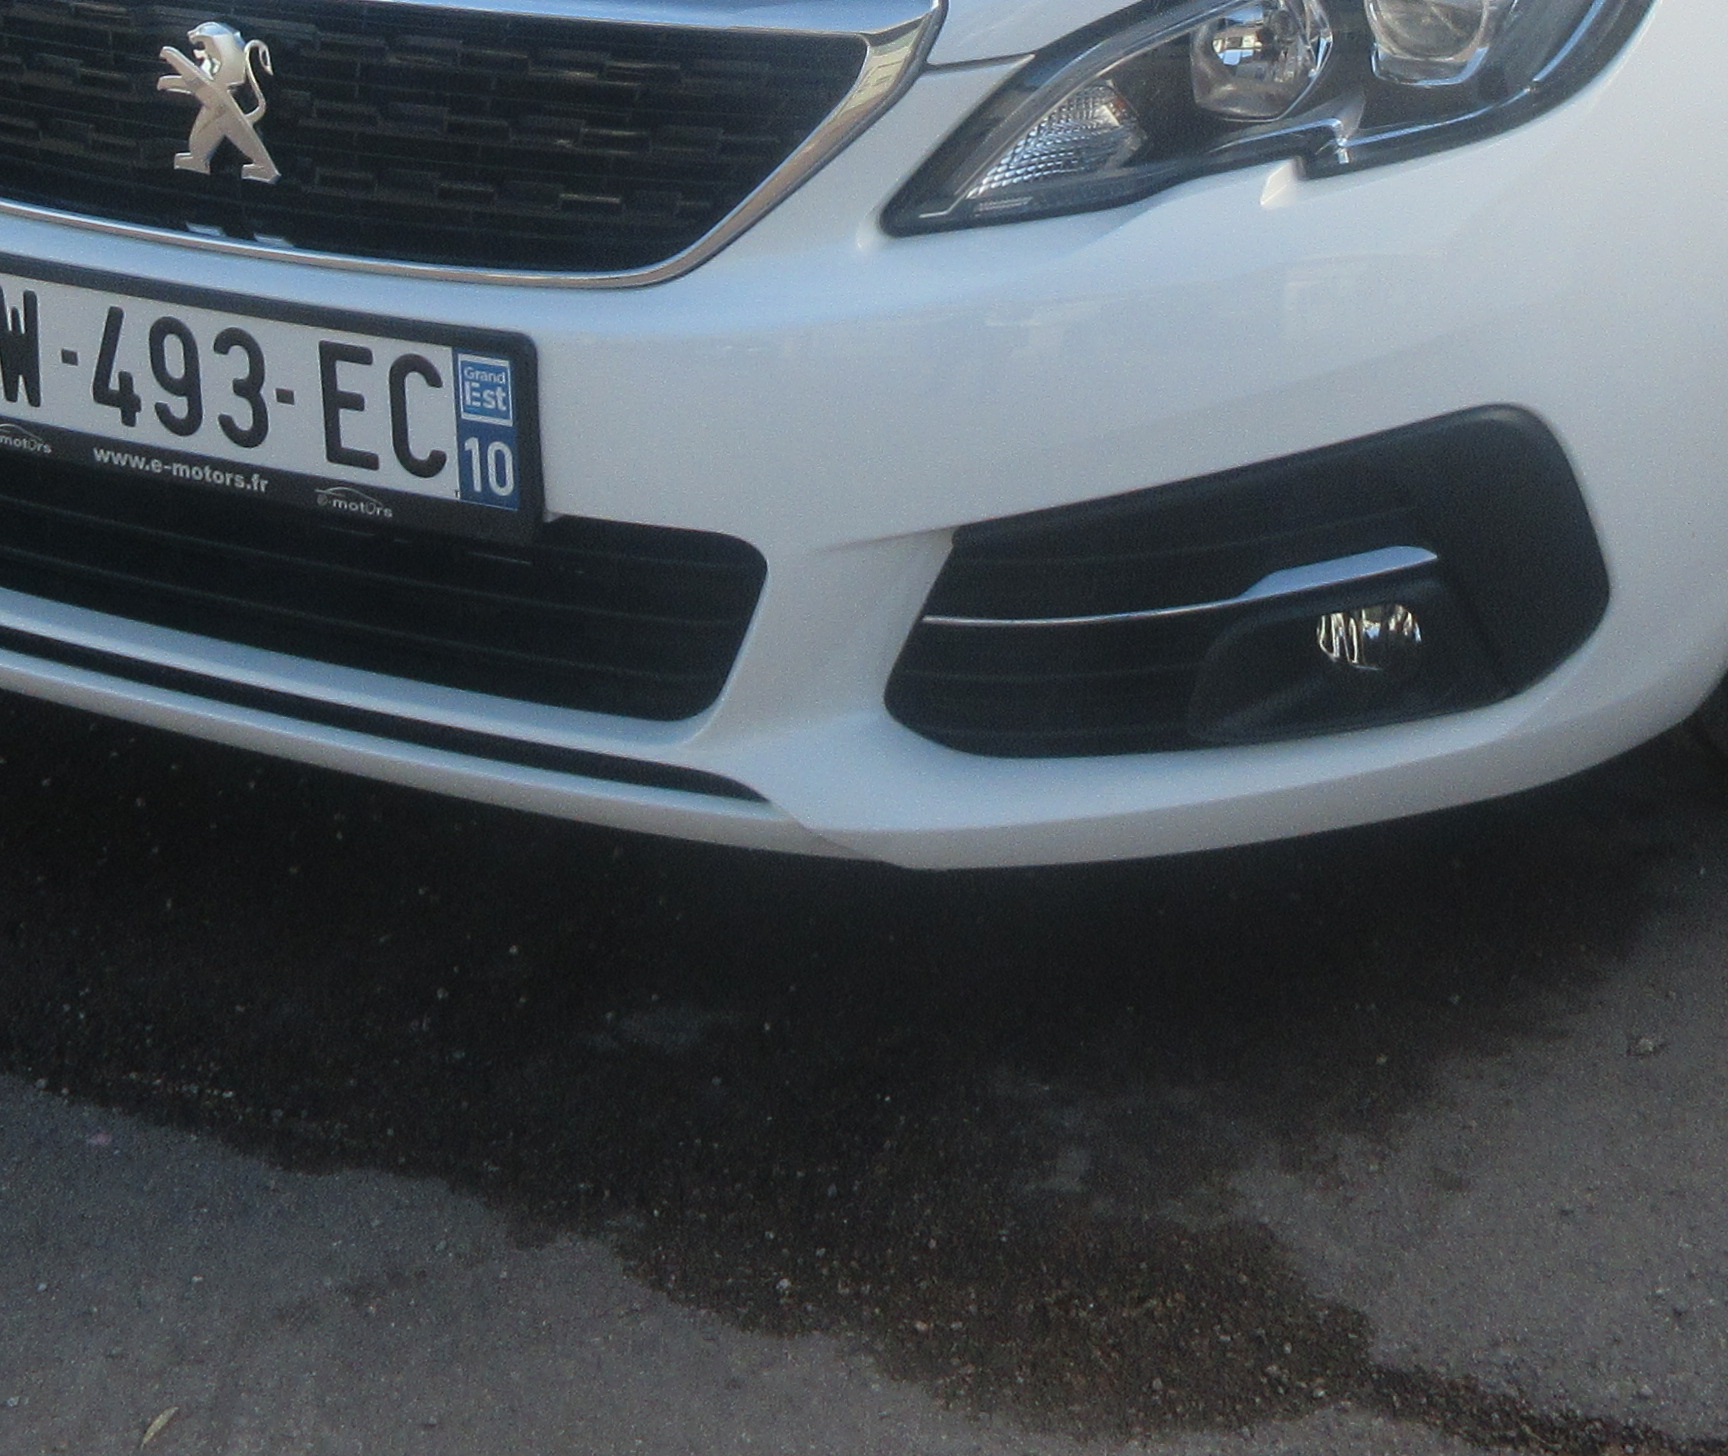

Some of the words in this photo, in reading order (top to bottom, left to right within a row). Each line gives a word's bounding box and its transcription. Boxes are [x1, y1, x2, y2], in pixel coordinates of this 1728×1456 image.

[463, 366, 507, 385] Grand
[464, 380, 508, 411] Est
[92, 446, 269, 493] www.e-motors.fr
[464, 436, 515, 496] 10
